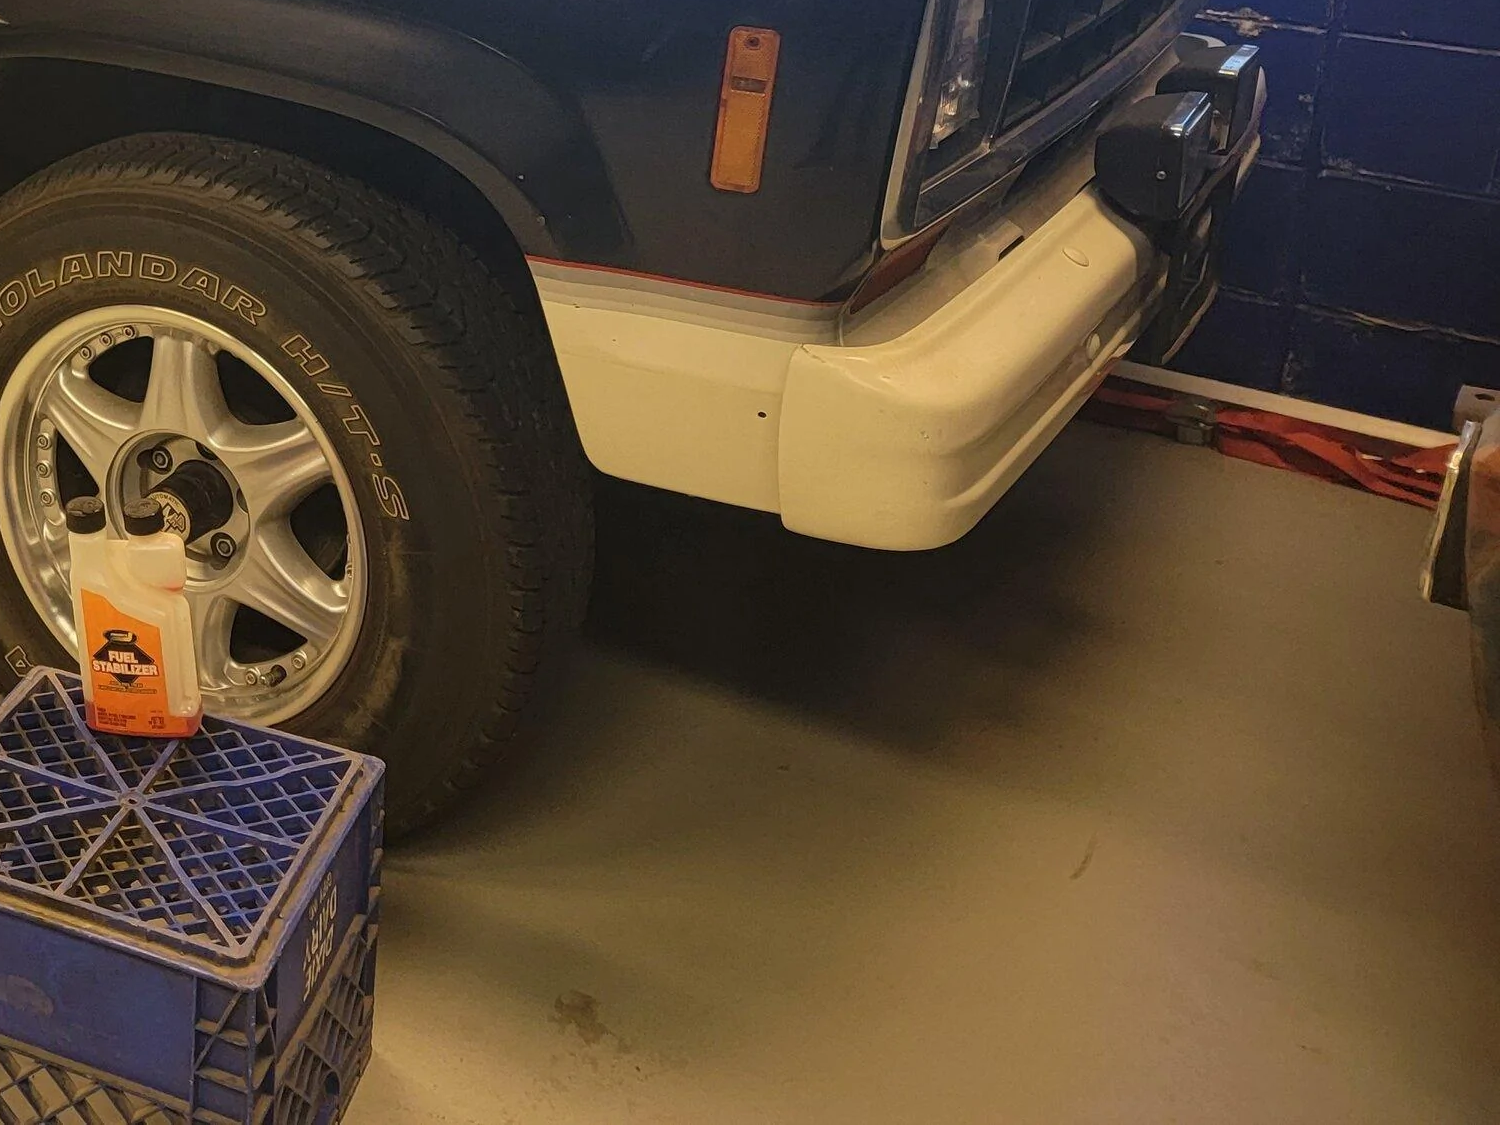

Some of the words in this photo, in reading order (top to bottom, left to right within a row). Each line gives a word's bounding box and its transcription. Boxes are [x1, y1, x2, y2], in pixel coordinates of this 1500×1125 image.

[108, 650, 139, 664] FUEL
[92, 660, 159, 676] STABILIZER
[302, 883, 337, 972] DAIRY
